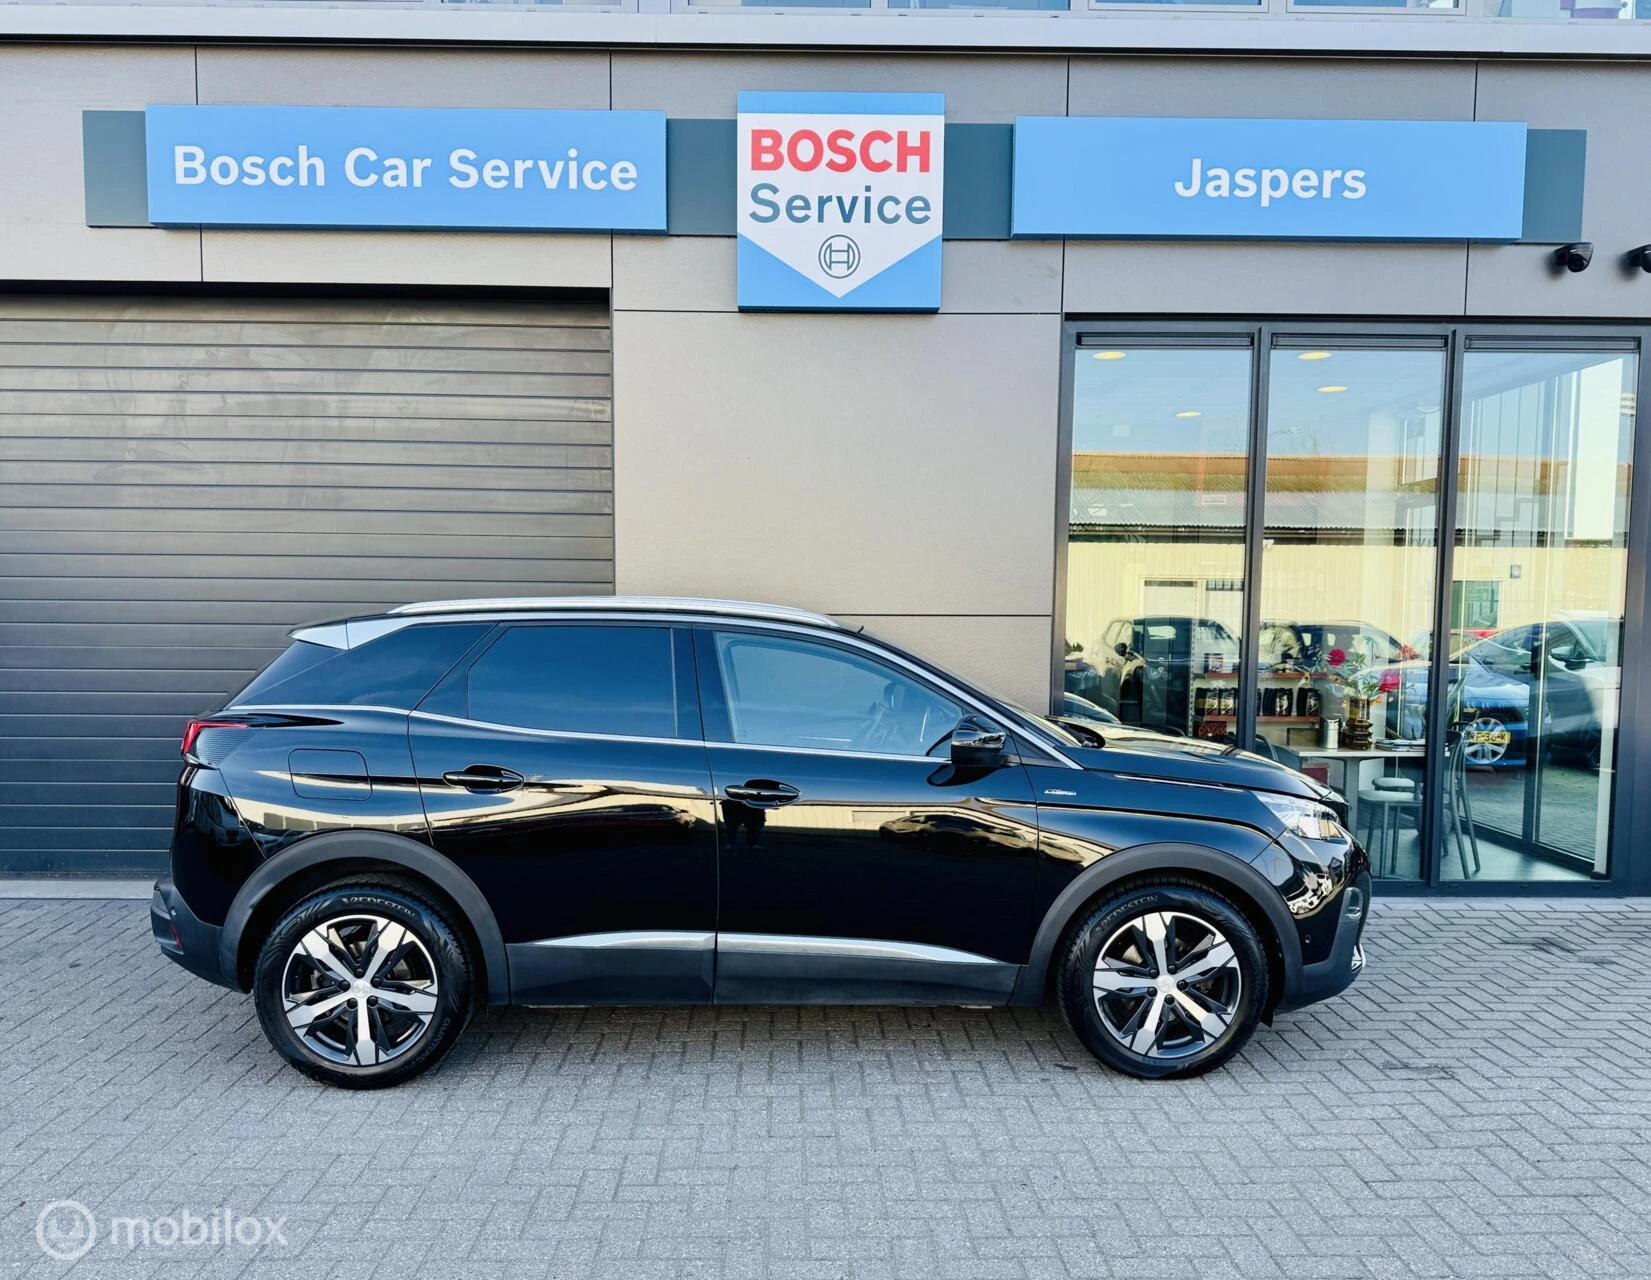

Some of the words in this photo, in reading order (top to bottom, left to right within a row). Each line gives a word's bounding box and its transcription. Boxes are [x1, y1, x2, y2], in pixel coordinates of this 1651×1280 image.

[174, 146, 325, 187] Bosch
[345, 148, 432, 188] Car
[449, 148, 638, 191] Service
[751, 129, 931, 173] BOSCH
[748, 183, 932, 225] Service
[1174, 158, 1367, 207] Jaspers
